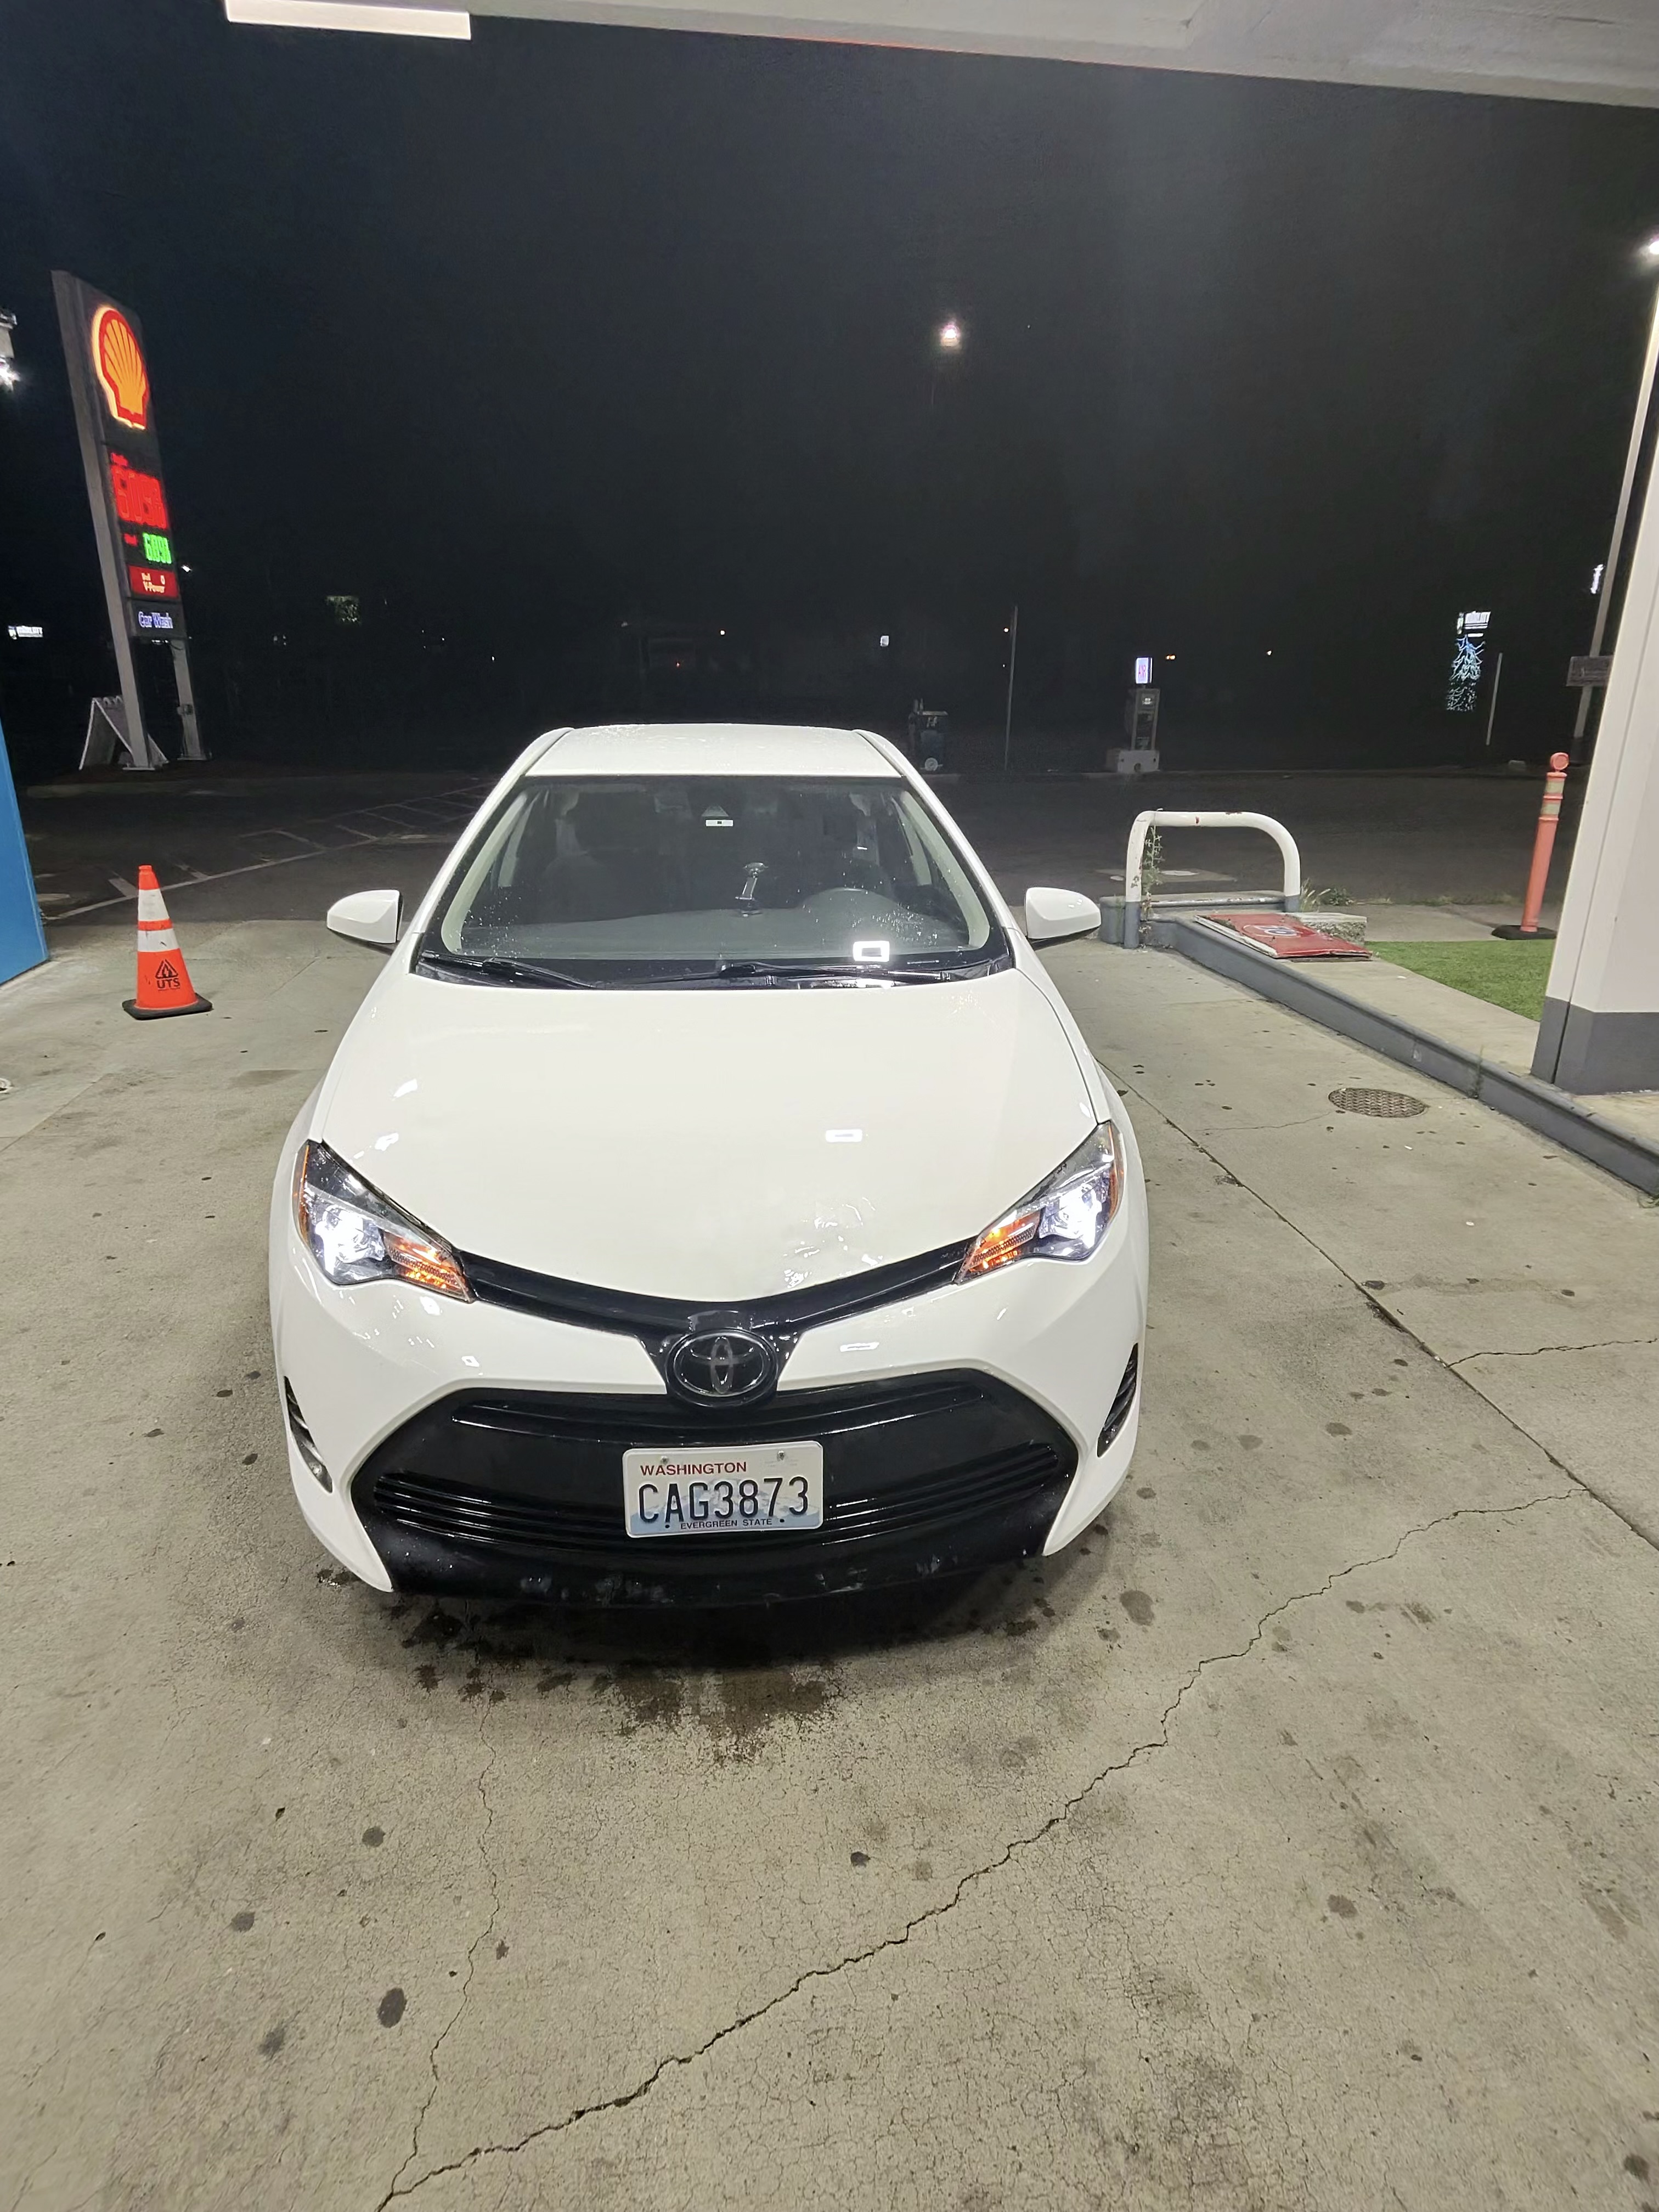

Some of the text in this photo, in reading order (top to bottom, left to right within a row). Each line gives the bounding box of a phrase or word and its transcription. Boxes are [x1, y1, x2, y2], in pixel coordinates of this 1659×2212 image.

[138, 611, 173, 629] Car Wash
[1138, 664, 1147, 678] AIR
[156, 978, 180, 989] UTS
[640, 1462, 747, 1476] WASHINGTON
[638, 1476, 809, 1523] CAG3873
[680, 1518, 772, 1530] EVERGREEN STATE
